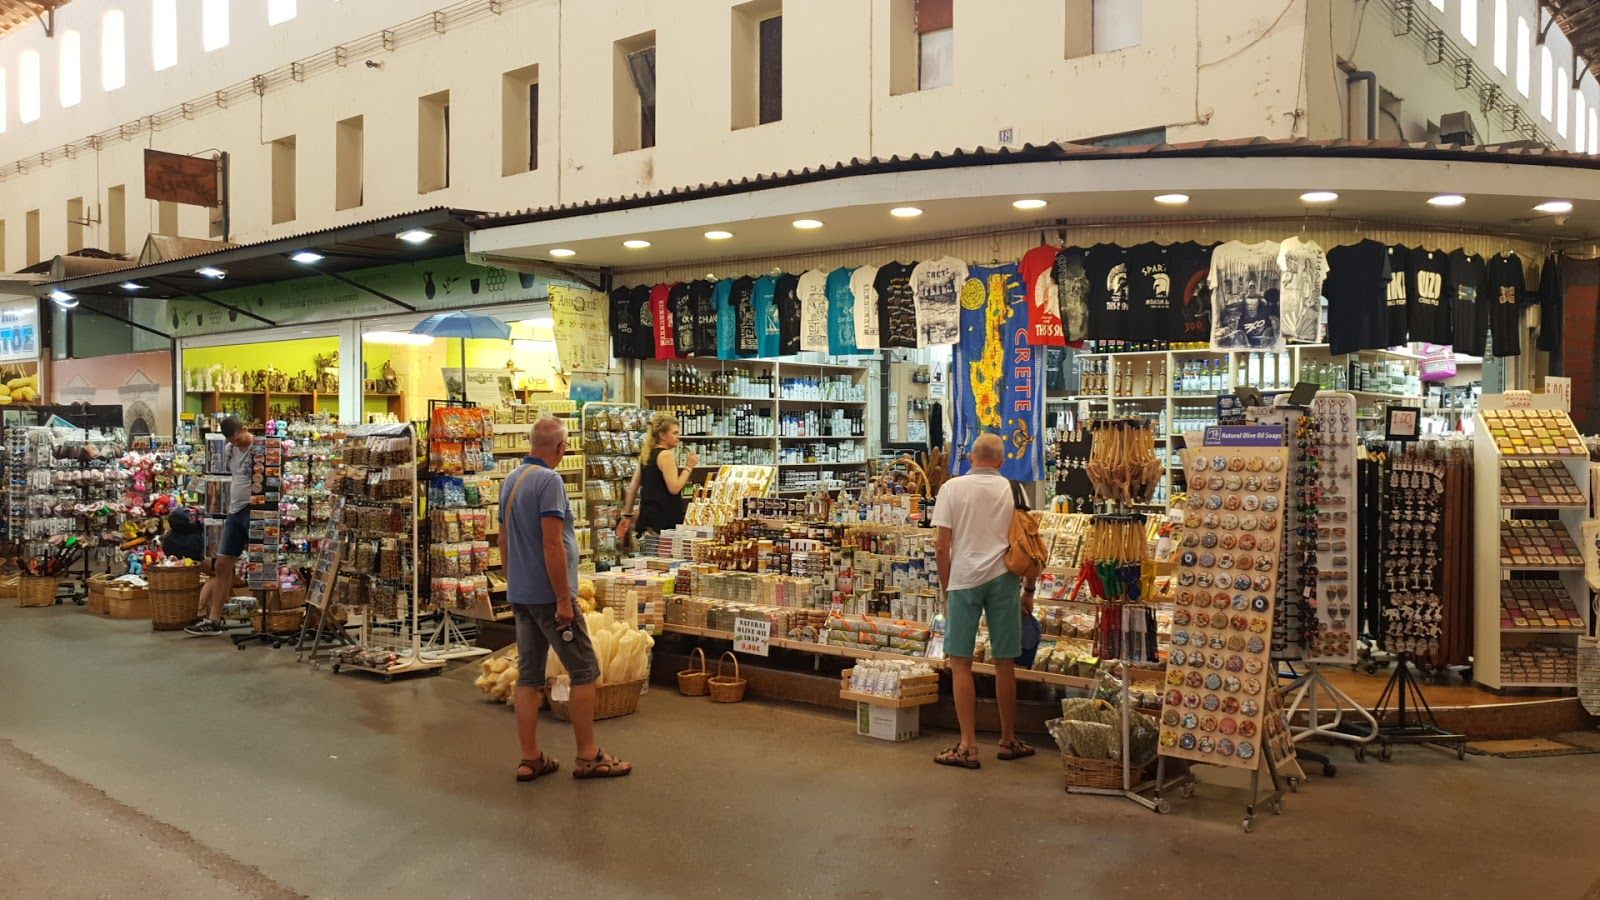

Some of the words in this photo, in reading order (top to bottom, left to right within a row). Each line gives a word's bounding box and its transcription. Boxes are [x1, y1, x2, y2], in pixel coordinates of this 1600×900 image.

[1015, 328, 1031, 412] CRETE
[1266, 433, 1282, 441] Soaps
[740, 620, 766, 629] NATURAL
[737, 627, 755, 635] OLIVE
